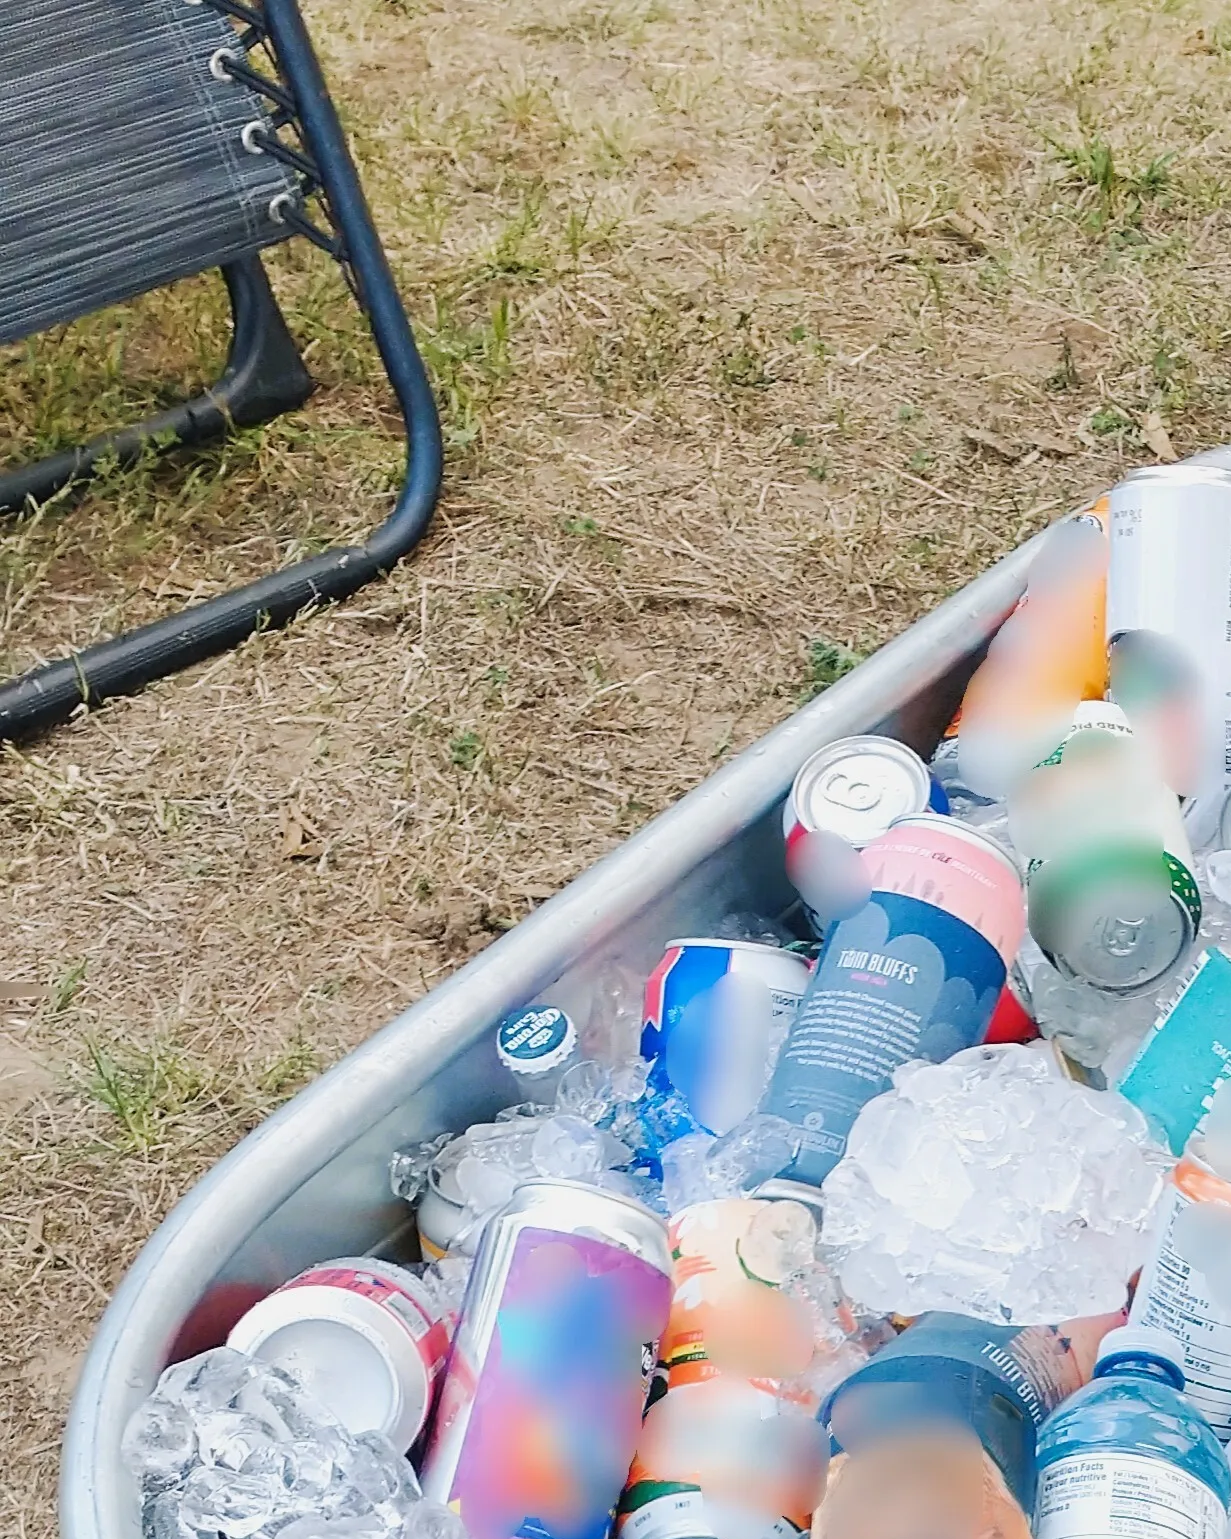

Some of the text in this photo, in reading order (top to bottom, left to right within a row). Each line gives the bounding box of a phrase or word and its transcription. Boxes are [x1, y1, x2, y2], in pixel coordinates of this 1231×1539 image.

[868, 954, 919, 985] BLUFFS
[503, 1008, 561, 1050] Corona
[1080, 1462, 1104, 1473] Facts
[1069, 1473, 1107, 1485] nutritive
